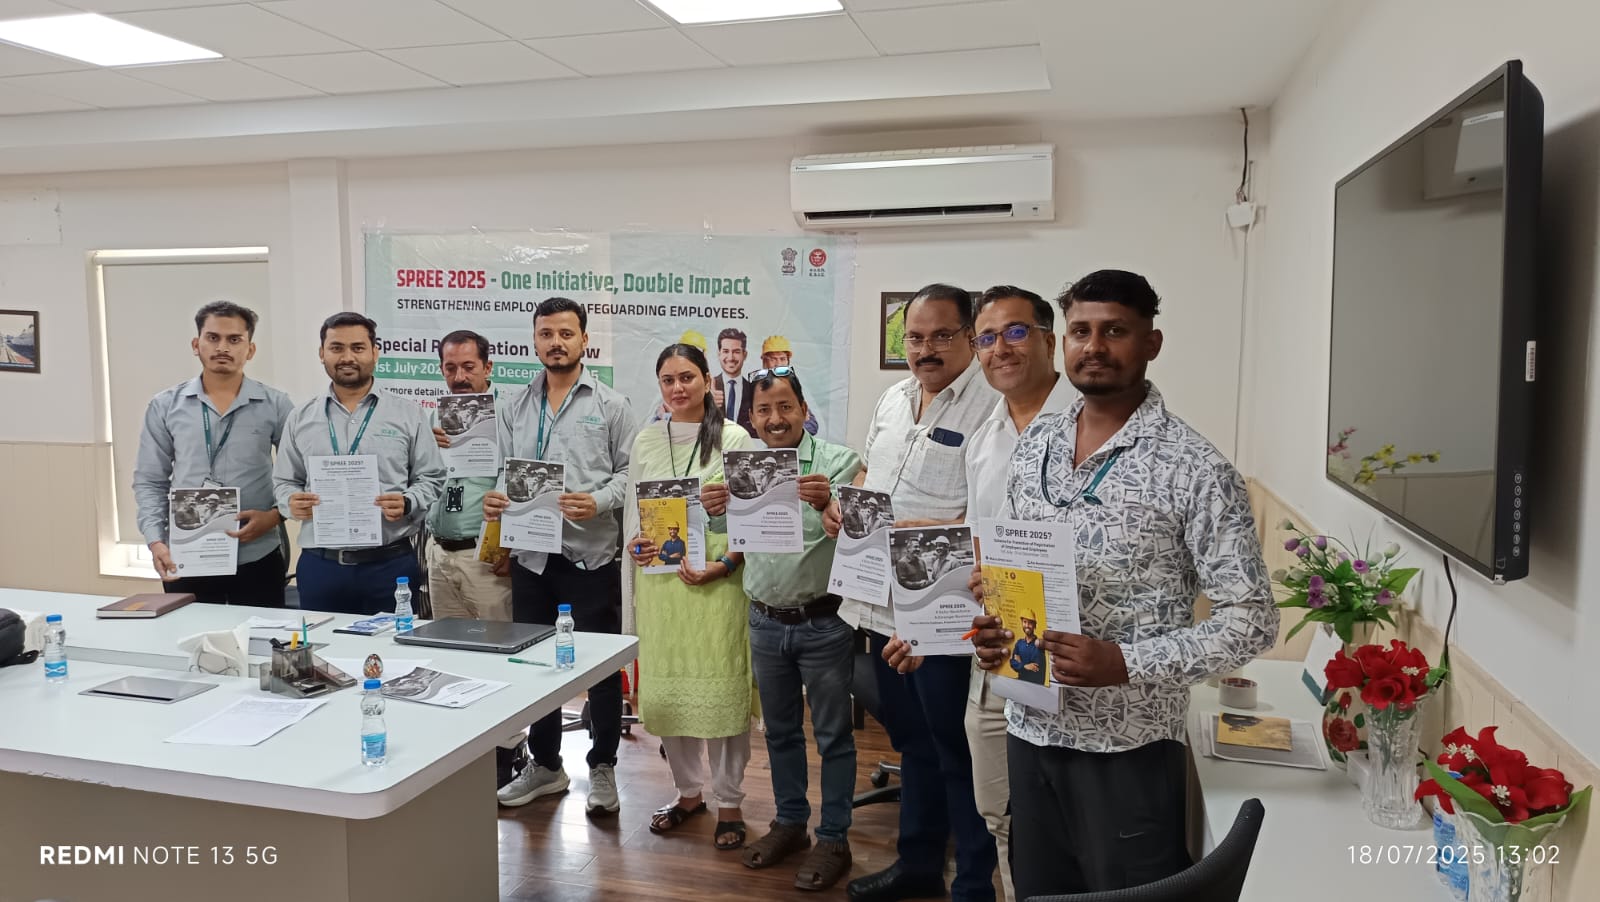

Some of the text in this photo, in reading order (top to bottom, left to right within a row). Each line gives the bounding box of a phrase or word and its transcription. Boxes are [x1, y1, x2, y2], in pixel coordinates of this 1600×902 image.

[396, 269, 444, 288] SPREE
[447, 270, 486, 289] 2025
[501, 271, 532, 290] One
[536, 271, 619, 295] Initiative,
[623, 272, 684, 293] Double
[689, 275, 751, 298] Impact
[397, 298, 491, 312] STRENGTHENING
[582, 303, 667, 317] FEGUARDING
[670, 305, 749, 320] EMPLOYEES.
[375, 338, 427, 354] Special
[393, 361, 417, 377] July
[419, 362, 442, 375] 202
[497, 365, 541, 379] Decem
[414, 387, 444, 397] details
[1005, 528, 1053, 540] SPREE 2025?
